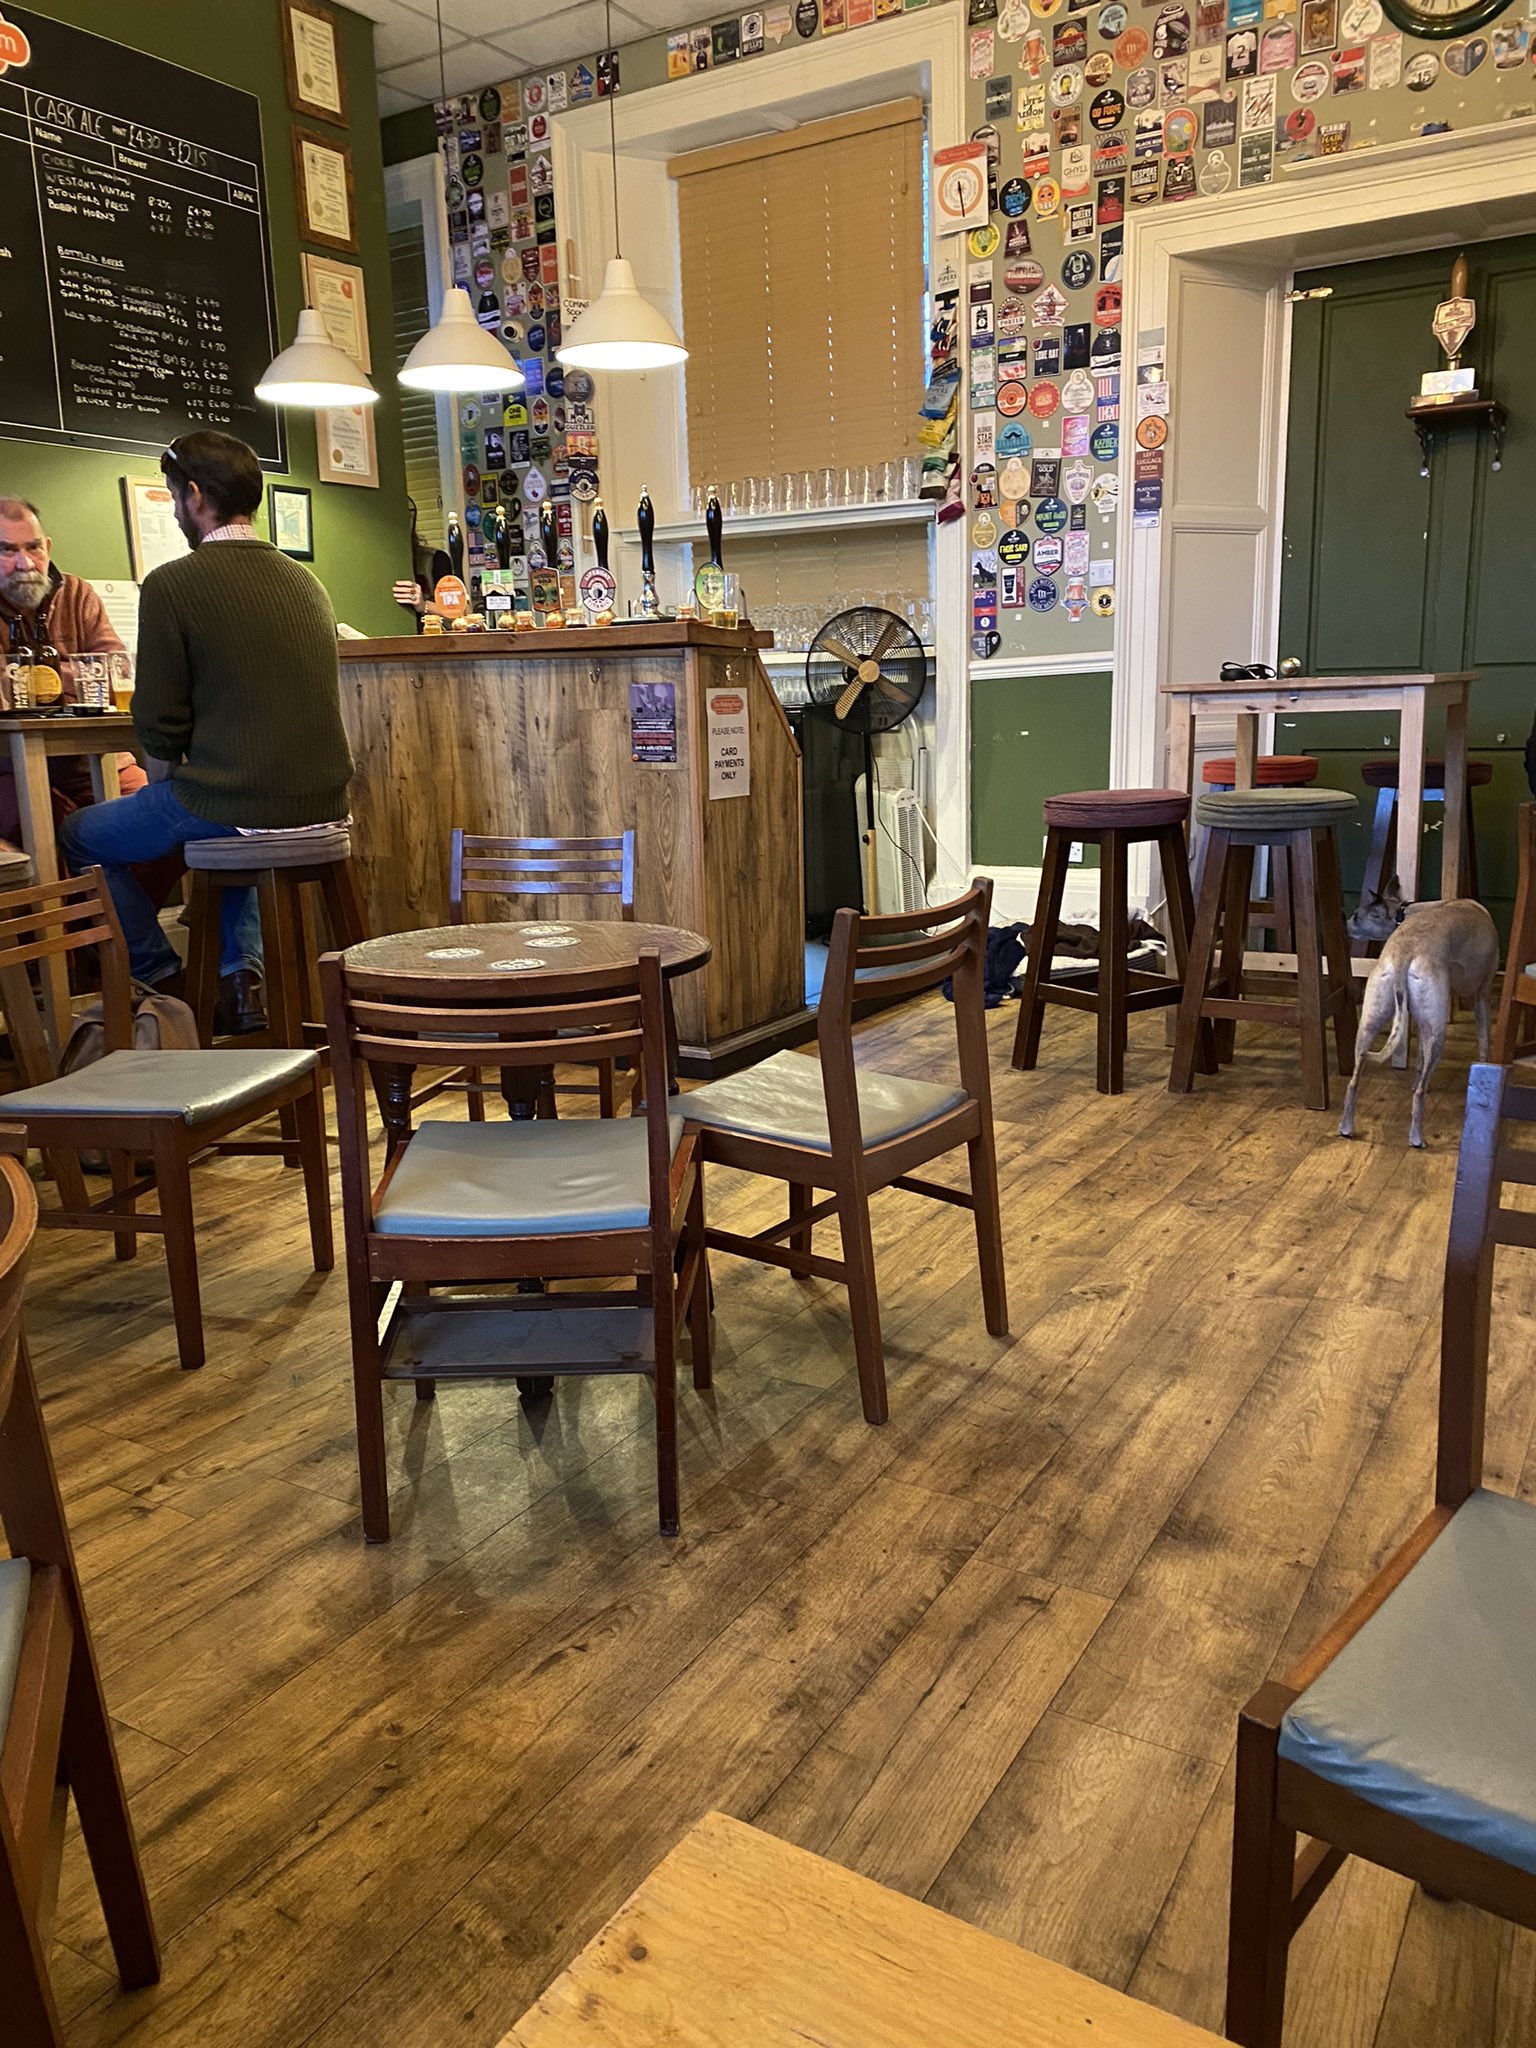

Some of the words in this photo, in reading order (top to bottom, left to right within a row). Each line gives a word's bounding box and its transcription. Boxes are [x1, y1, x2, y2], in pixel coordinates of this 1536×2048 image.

[1236, 45, 1246, 59] 2
[1417, 70, 1431, 83] 15
[35, 96, 76, 129] CASK
[80, 110, 106, 139] ALE
[35, 126, 63, 144] Name
[118, 153, 148, 169] Brewer
[41, 153, 76, 169] CIDER
[1063, 164, 1088, 176] GHYLL
[1131, 166, 1158, 179] BESPOKE
[44, 171, 97, 190] WESTONS
[98, 183, 137, 201] VINTAGE
[46, 185, 100, 206] STOWFORD
[104, 198, 130, 212] PRESS
[937, 272, 958, 283] PIPERS
[563, 299, 590, 308] COMING
[1000, 317, 1024, 326] PORTER
[508, 406, 522, 415] ONE
[564, 423, 596, 431] GUZZLER
[977, 433, 993, 445] STAR
[1136, 457, 1162, 465] LUGGAGE
[584, 569, 611, 581] LIFEBOAT
[441, 592, 460, 606] IPA
[585, 599, 611, 610] TITANIC
[712, 727, 730, 735] PLEASE
[721, 747, 737, 756] CARD
[714, 759, 745, 769] PAYMENTS
[721, 771, 737, 780] ONLY
